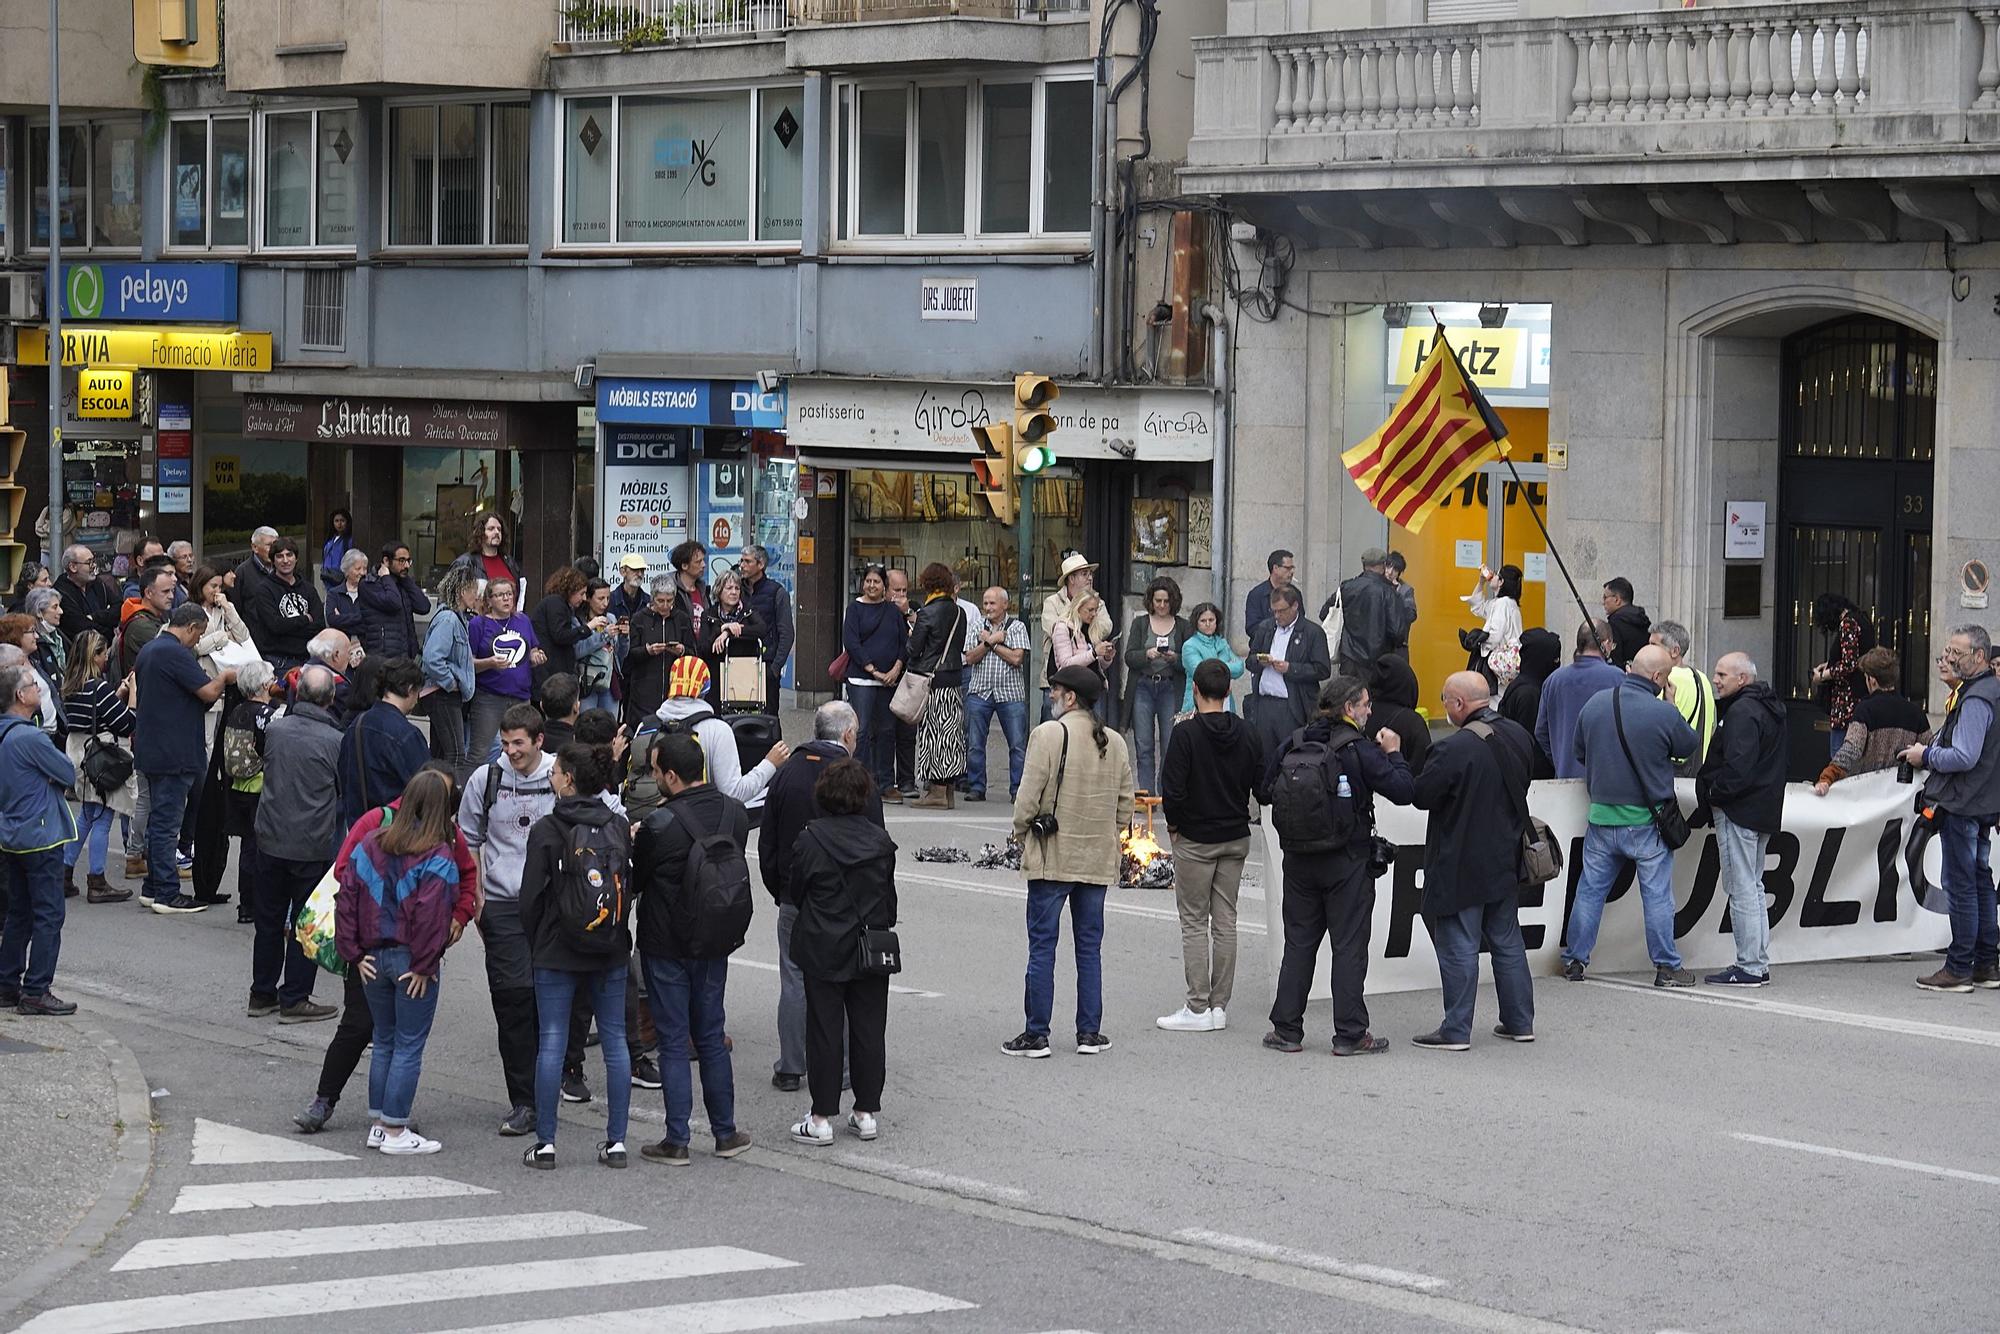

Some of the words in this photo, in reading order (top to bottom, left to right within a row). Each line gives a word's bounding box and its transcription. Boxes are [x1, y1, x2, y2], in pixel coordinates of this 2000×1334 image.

[625, 220, 647, 228] TATTOO
[653, 219, 715, 228] MICROPIGMENTATION
[716, 218, 746, 227] ACADEMY
[121, 268, 189, 313] pelayo
[940, 286, 975, 311] JUBERT
[81, 335, 110, 362] VIA
[152, 338, 212, 366] Formació
[219, 338, 258, 367] Viària
[1414, 339, 1500, 375] Hrtz
[88, 378, 123, 391] AUTO
[81, 397, 129, 411] ESCOLA
[608, 387, 649, 408] MÒBILS
[651, 387, 697, 409] ESTACIÓ
[316, 398, 411, 439] L'Artistica
[466, 405, 499, 421] Quadres
[799, 404, 865, 421] pastisseria
[247, 415, 274, 433] Galeria
[1079, 409, 1096, 429] de
[1102, 415, 1119, 435] pa
[424, 423, 455, 440] Articles
[458, 424, 499, 441] Decoració
[616, 443, 676, 459] DIGI
[215, 461, 235, 472] FOR
[215, 474, 235, 484] VIA
[620, 481, 668, 496] MÒBILS
[619, 496, 671, 513] ESTACIÓ
[1903, 494, 1924, 514] 33
[612, 530, 659, 543] Reparació
[714, 521, 729, 538] ria
[609, 545, 621, 554] en
[623, 543, 636, 554] 45
[637, 543, 670, 554] minuts
[609, 574, 621, 585] de
